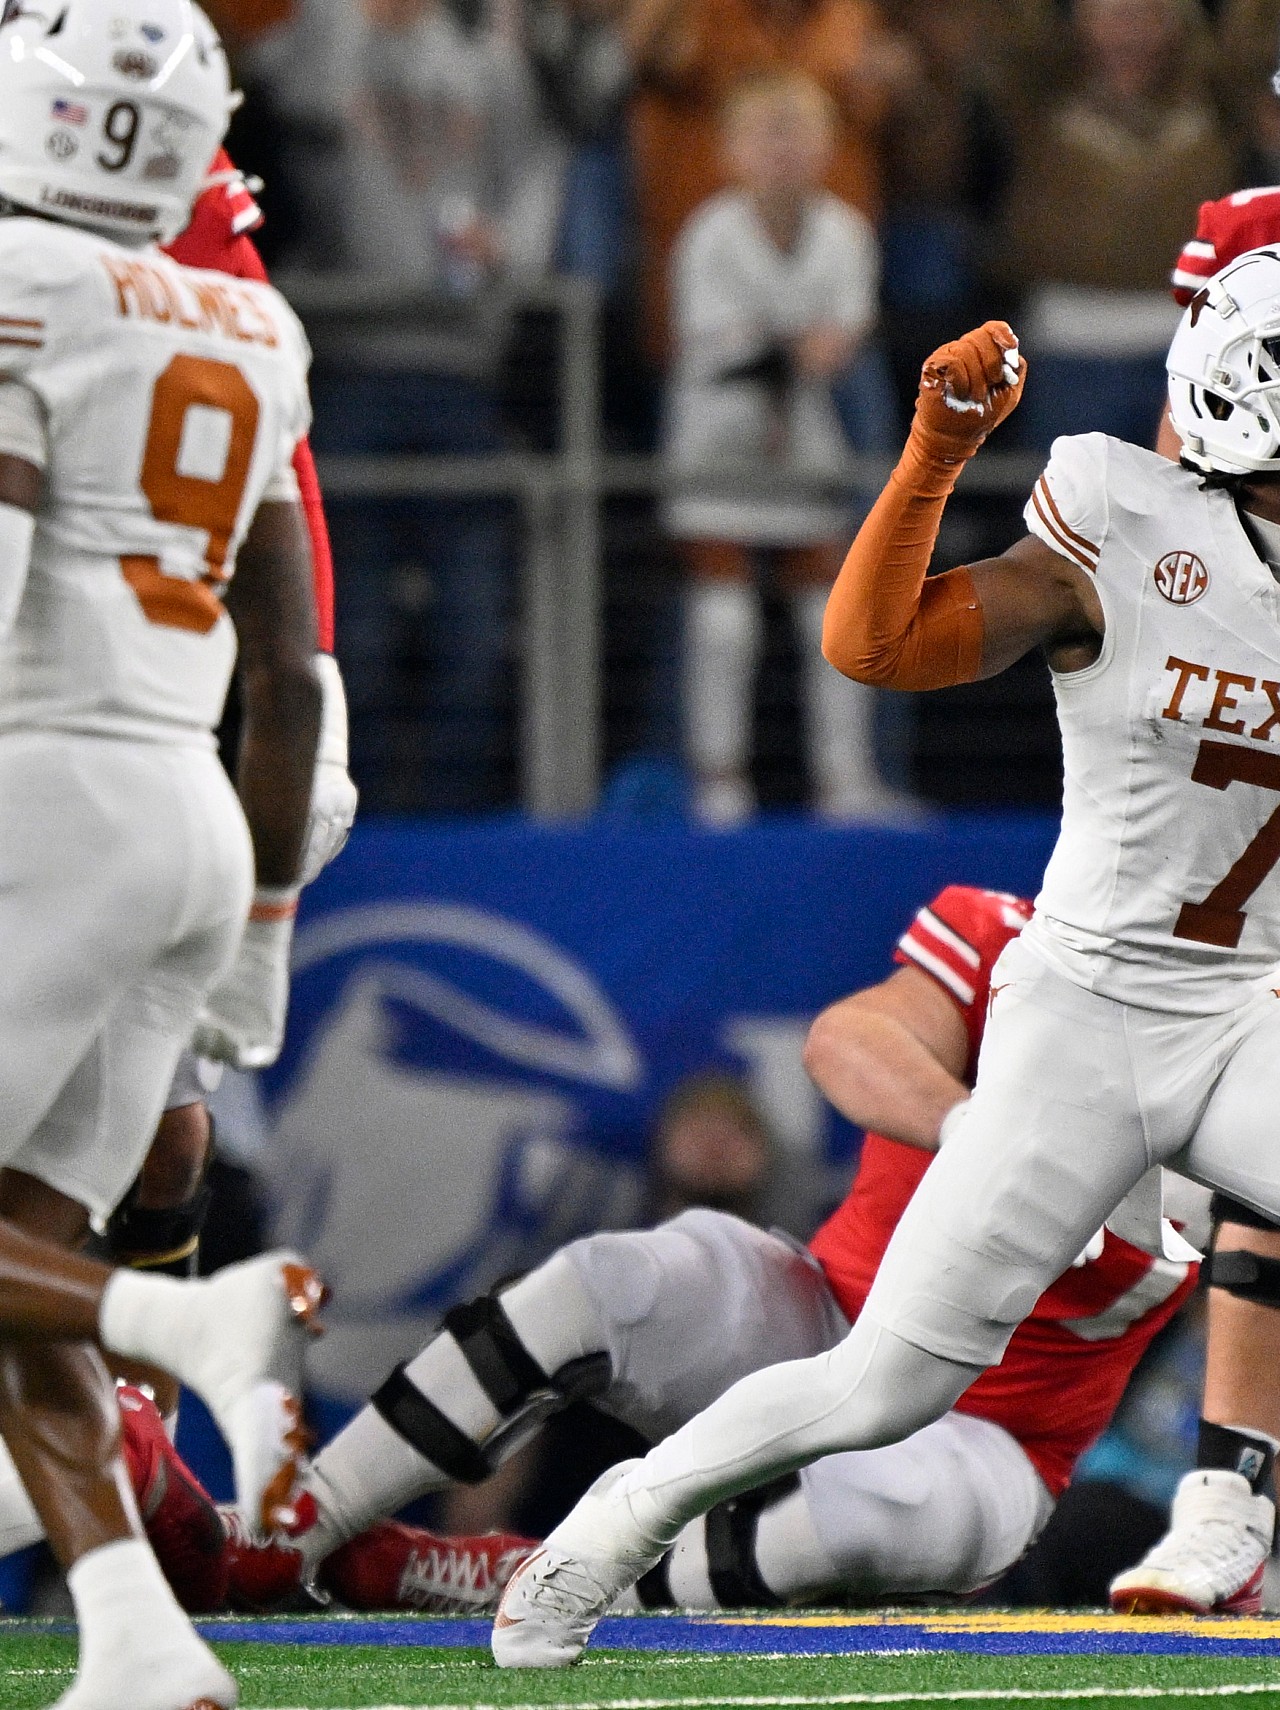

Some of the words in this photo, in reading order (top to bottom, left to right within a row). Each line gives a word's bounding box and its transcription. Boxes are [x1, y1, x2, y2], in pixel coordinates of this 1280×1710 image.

[97, 101, 140, 172] 9
[119, 353, 260, 634] 9
[1157, 553, 1206, 601] SEC
